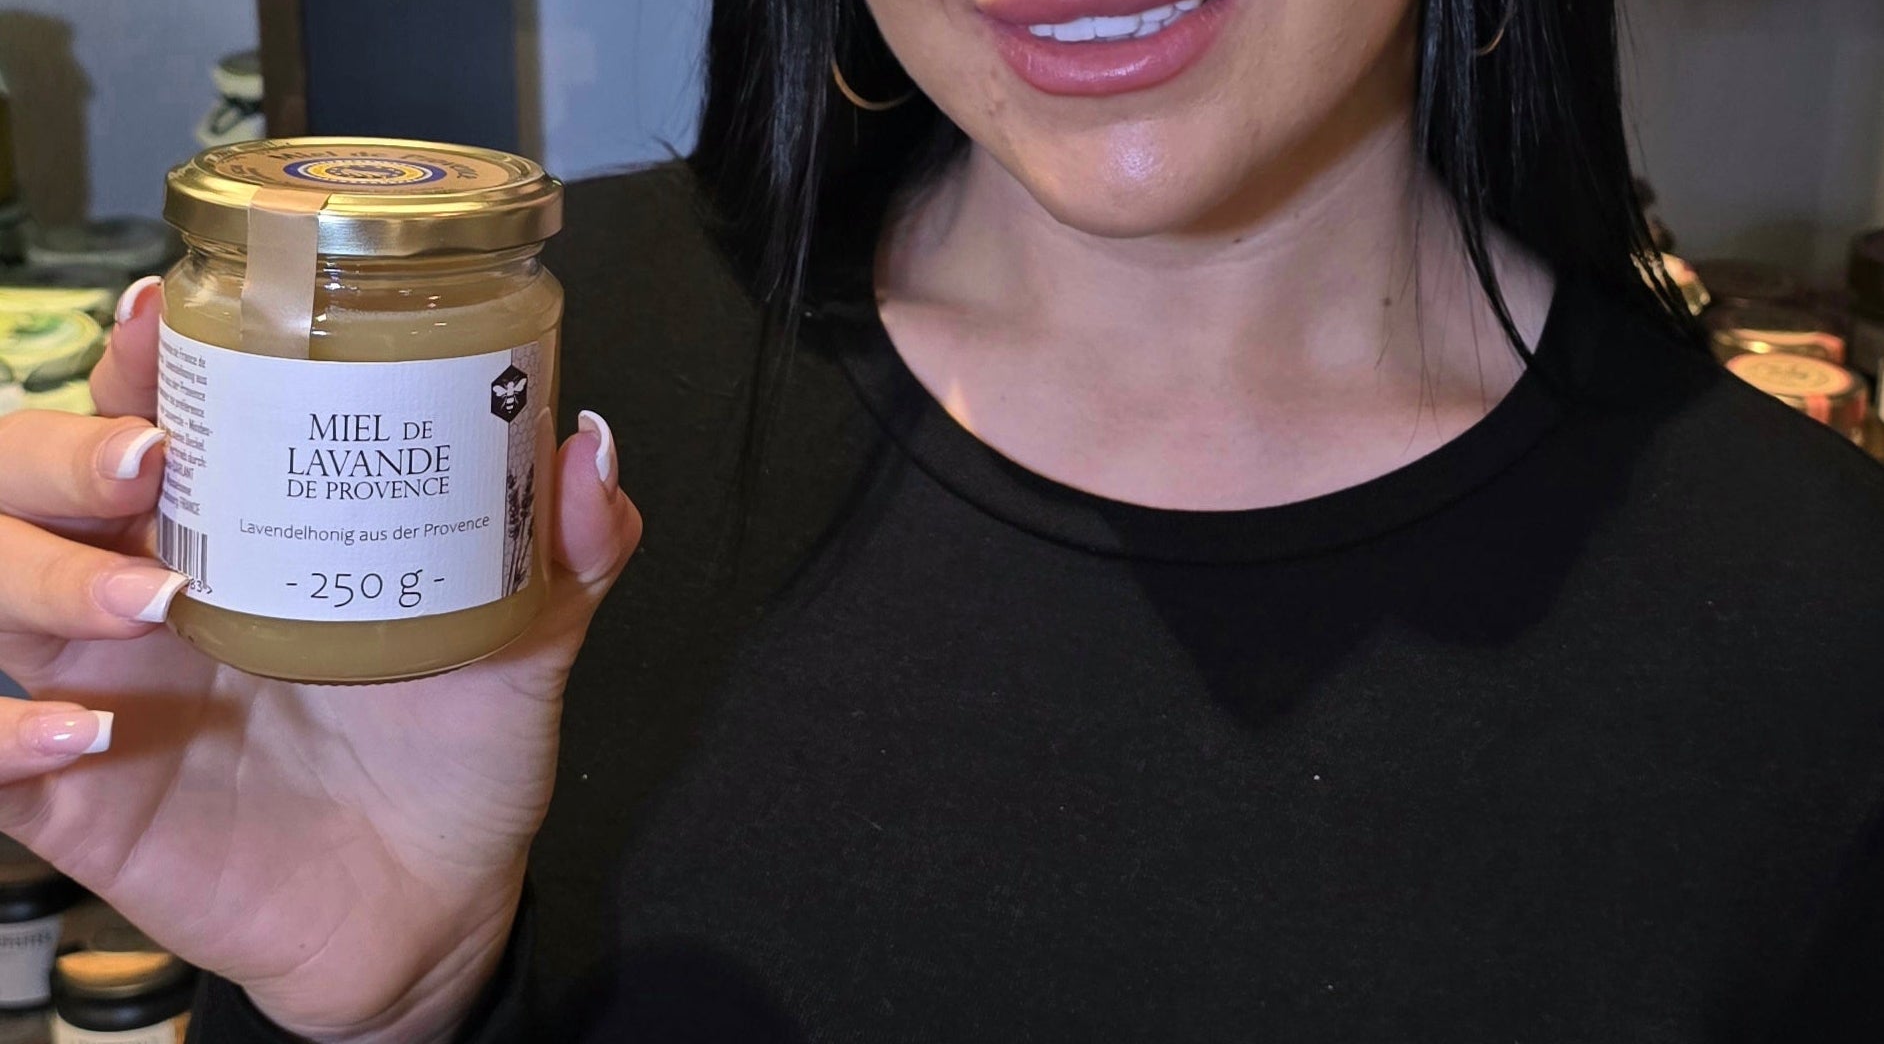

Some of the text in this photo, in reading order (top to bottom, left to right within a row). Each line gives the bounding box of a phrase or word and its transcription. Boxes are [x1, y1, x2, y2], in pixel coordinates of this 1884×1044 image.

[308, 413, 433, 442] MIEL DE
[287, 444, 451, 478] LAVANDE
[286, 476, 450, 500] DE PROVENCE
[240, 514, 491, 546] Lavendelhonig aus der Provence
